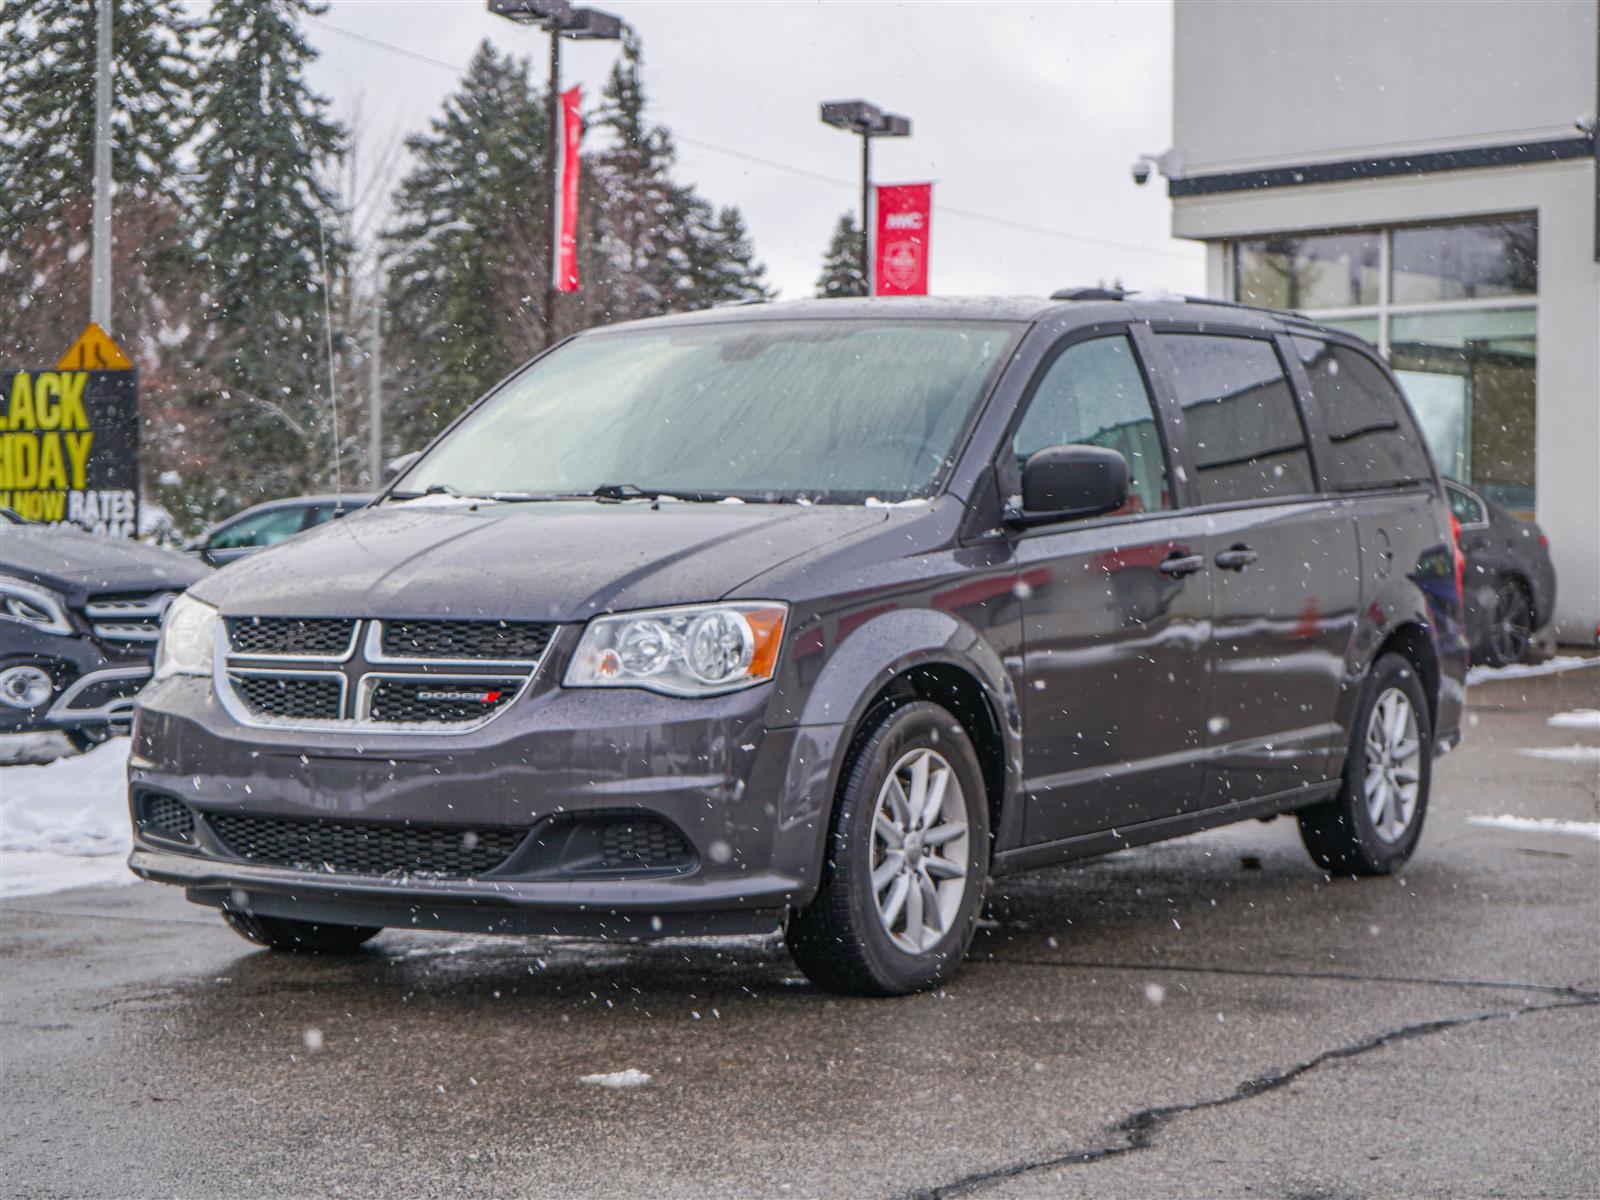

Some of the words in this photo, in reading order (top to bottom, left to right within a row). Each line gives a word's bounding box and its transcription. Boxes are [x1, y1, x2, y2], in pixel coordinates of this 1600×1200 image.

[0, 432, 94, 490] IDAY
[14, 490, 65, 521] NOW
[69, 490, 135, 521] RATES
[417, 691, 489, 701] DODGE
